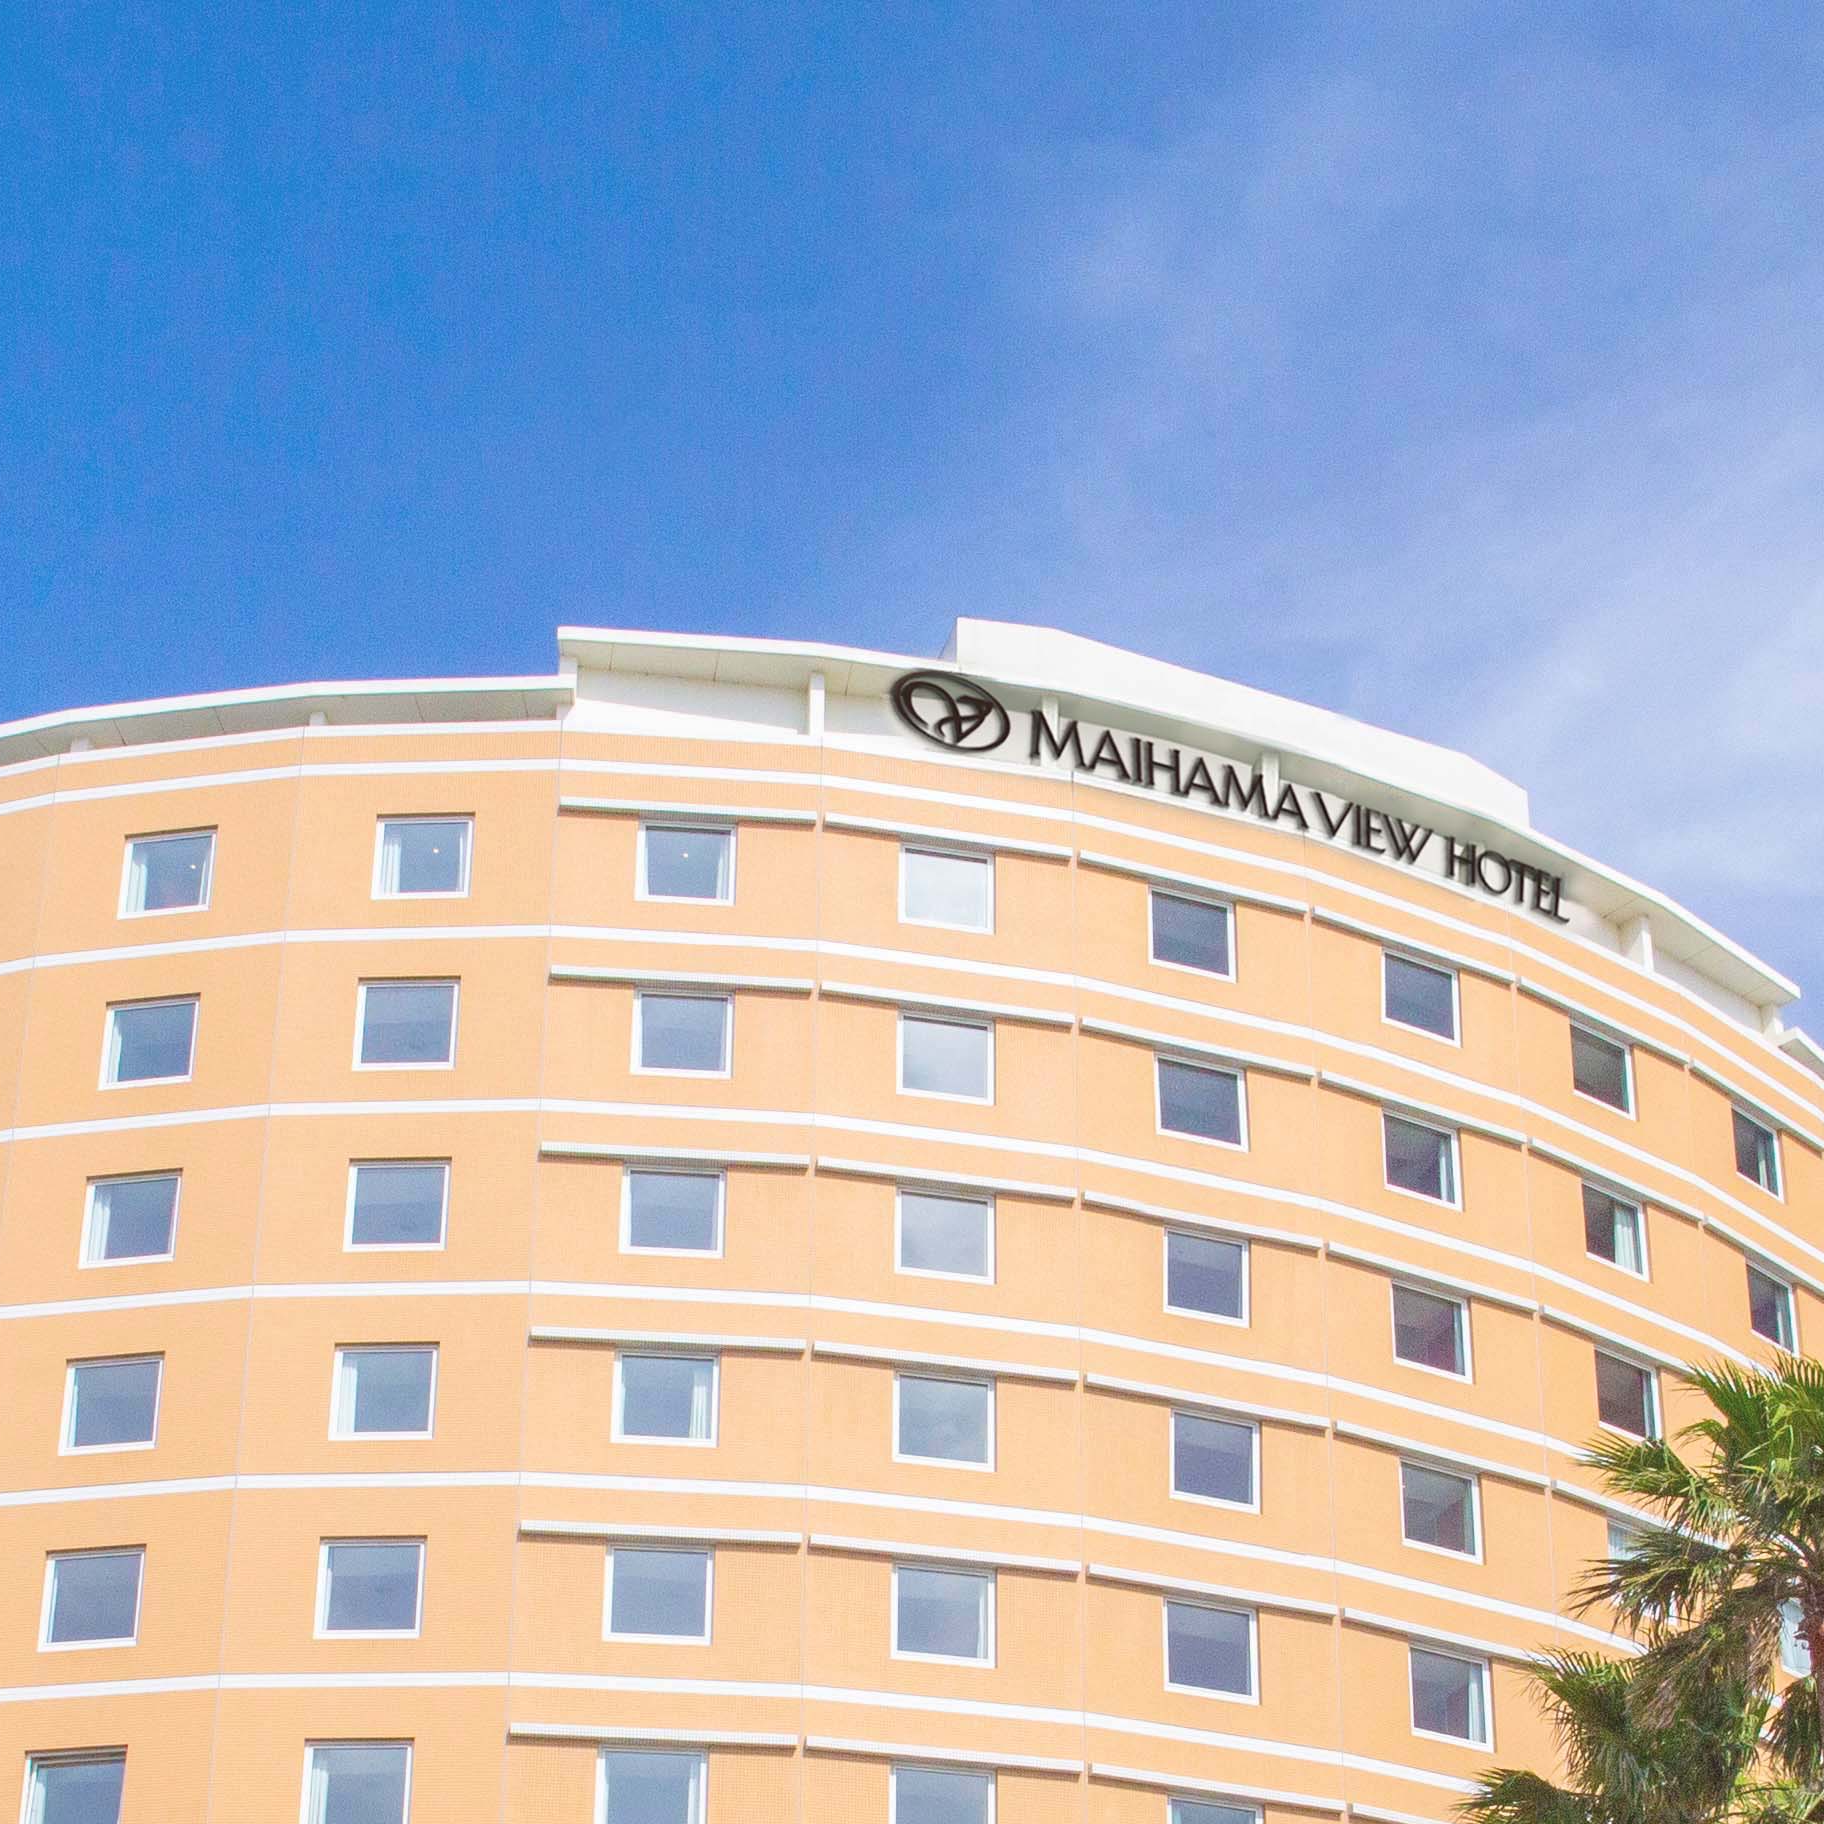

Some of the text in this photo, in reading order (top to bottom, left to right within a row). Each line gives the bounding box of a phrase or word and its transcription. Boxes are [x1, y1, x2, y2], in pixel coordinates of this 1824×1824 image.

[1029, 708, 1571, 924] MAIHAMA VIEW HOTEL
